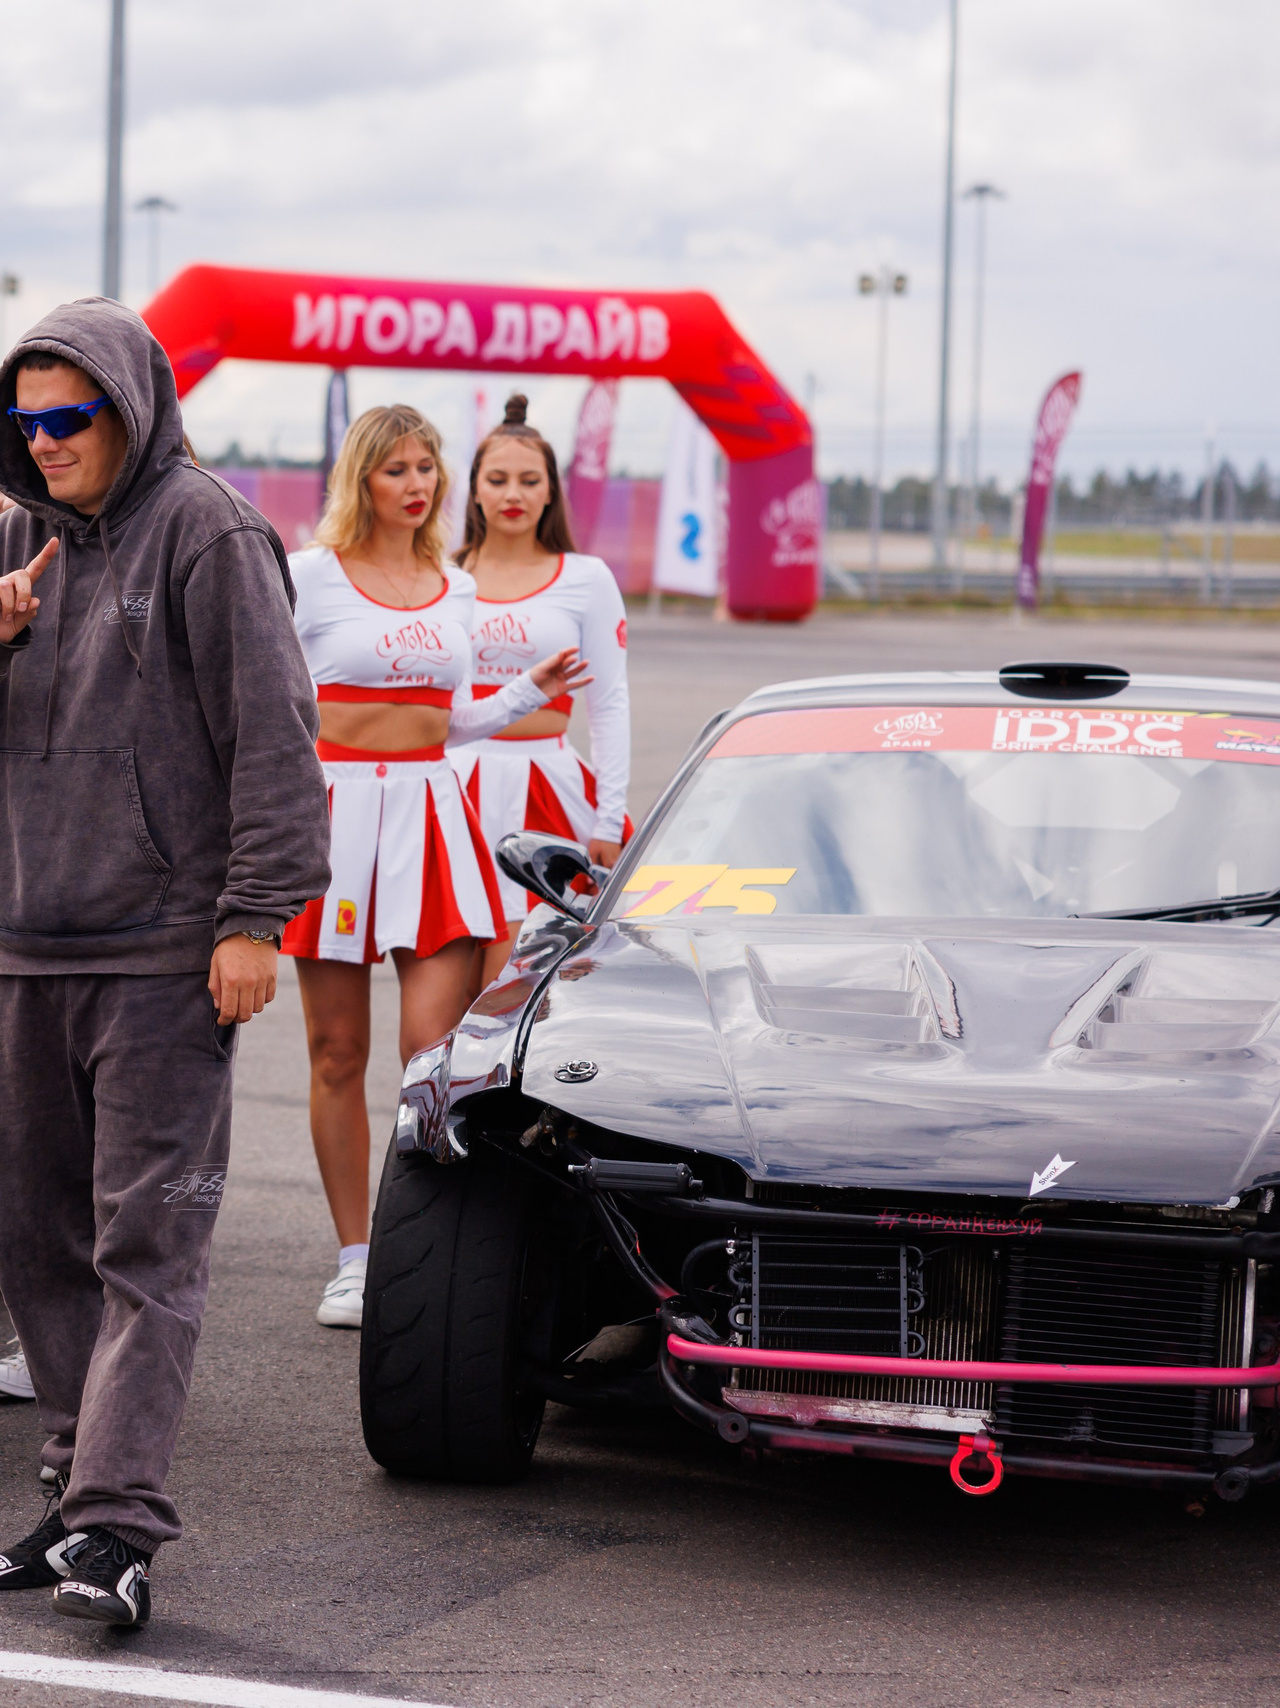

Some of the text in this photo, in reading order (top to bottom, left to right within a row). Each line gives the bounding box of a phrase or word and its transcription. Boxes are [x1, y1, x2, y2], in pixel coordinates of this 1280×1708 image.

[291, 292, 671, 363] ИГОРА ДРАЙВ
[997, 709, 1185, 724] IGORA DRIVE
[993, 717, 1183, 748] IDDC
[991, 741, 1184, 757] DRIFT CHALLENGE
[620, 864, 797, 918] 75
